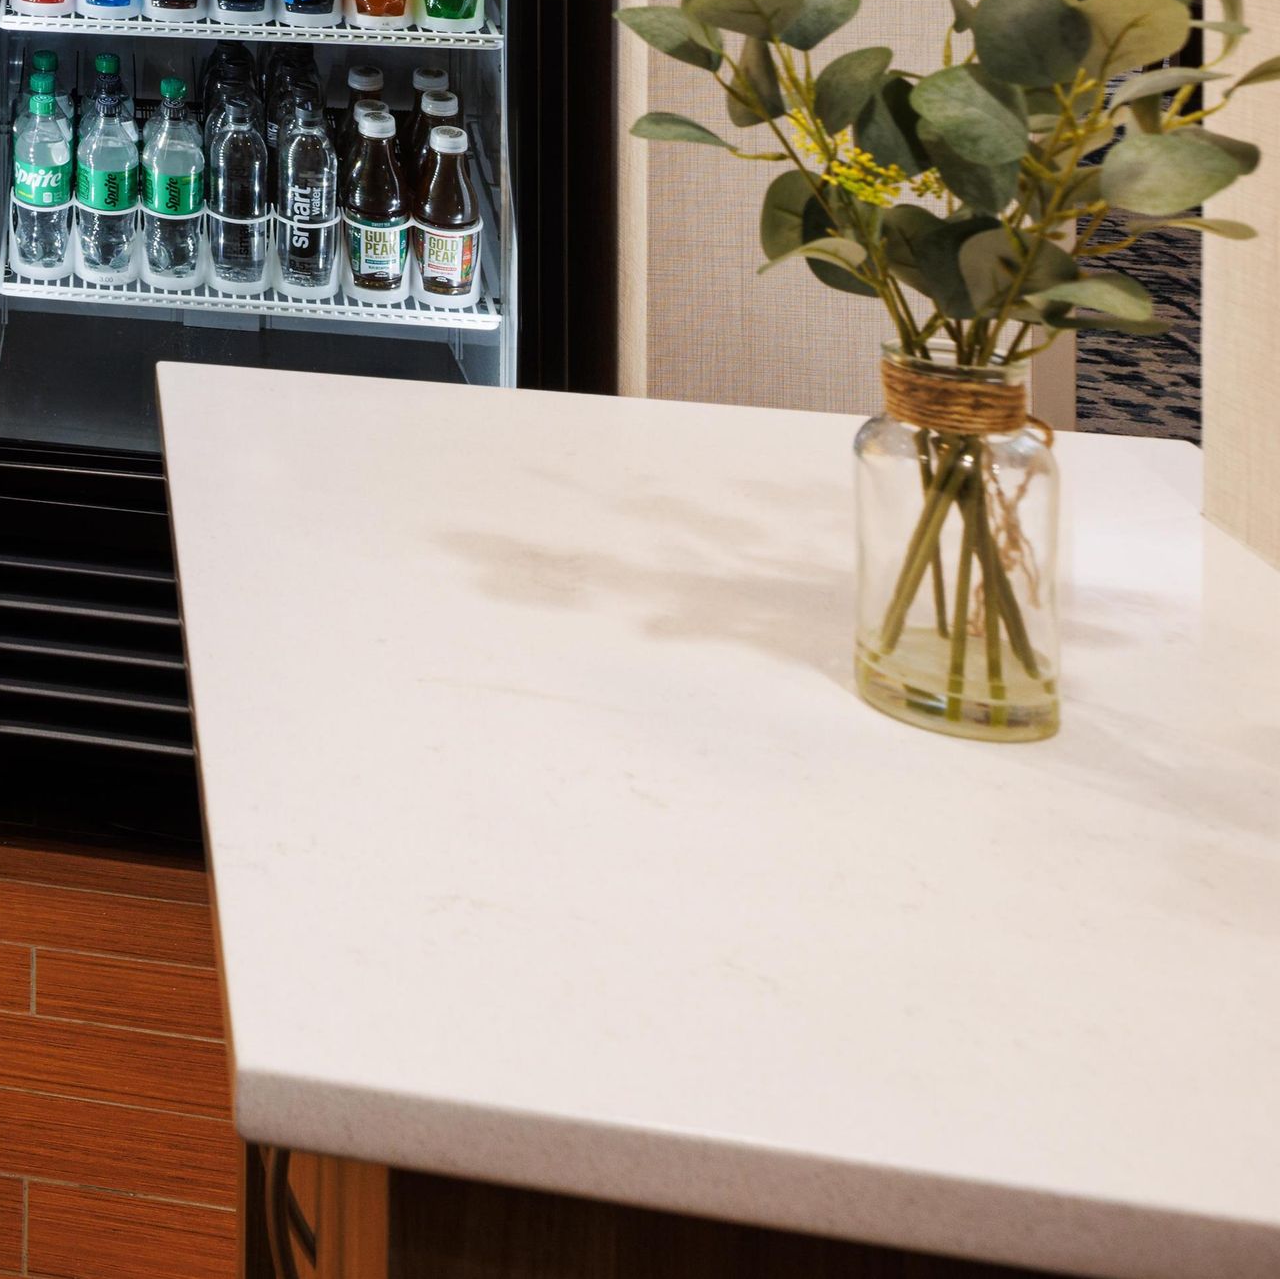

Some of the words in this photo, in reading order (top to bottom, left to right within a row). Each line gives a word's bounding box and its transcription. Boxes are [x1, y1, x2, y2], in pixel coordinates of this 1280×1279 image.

[15, 163, 62, 188] Sprite
[104, 174, 118, 208] Sprite
[165, 177, 179, 211] Sprite
[312, 187, 322, 216] water
[292, 183, 310, 249] smart
[364, 230, 397, 244] GOLD
[364, 242, 397, 255] PEAK
[428, 237, 458, 252] GOLD
[428, 250, 458, 263] PEAK
